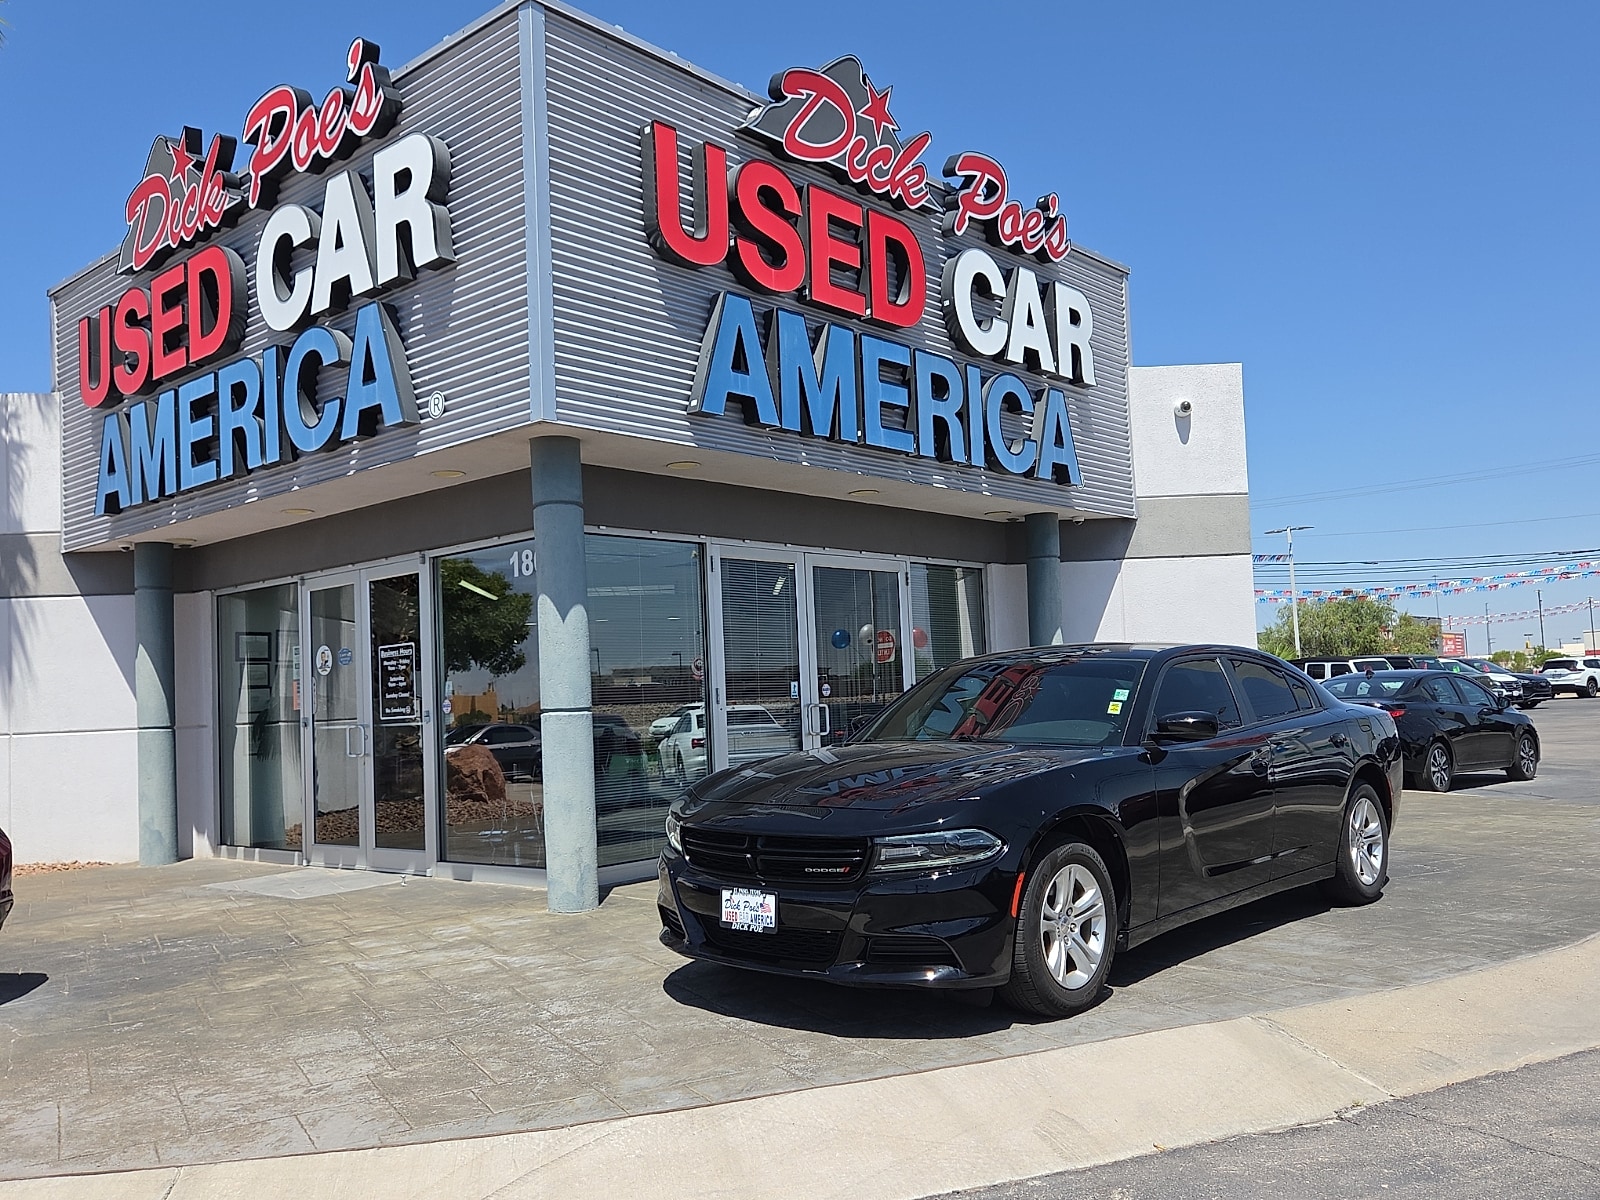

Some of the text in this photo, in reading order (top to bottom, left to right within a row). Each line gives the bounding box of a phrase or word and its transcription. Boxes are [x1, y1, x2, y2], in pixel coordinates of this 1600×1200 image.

[126, 37, 385, 272] Dick Poe's
[781, 67, 1071, 262] Dick Poe's
[78, 131, 444, 408] USED CAR
[652, 120, 1097, 388] USED CAR
[94, 301, 403, 518] AMERICA
[701, 291, 1083, 488] AMERICA
[510, 549, 537, 577] 18
[724, 899, 759, 912] Dick Poe's
[725, 910, 773, 927] USED CAR AMERICA
[731, 922, 764, 932] DICK POE
